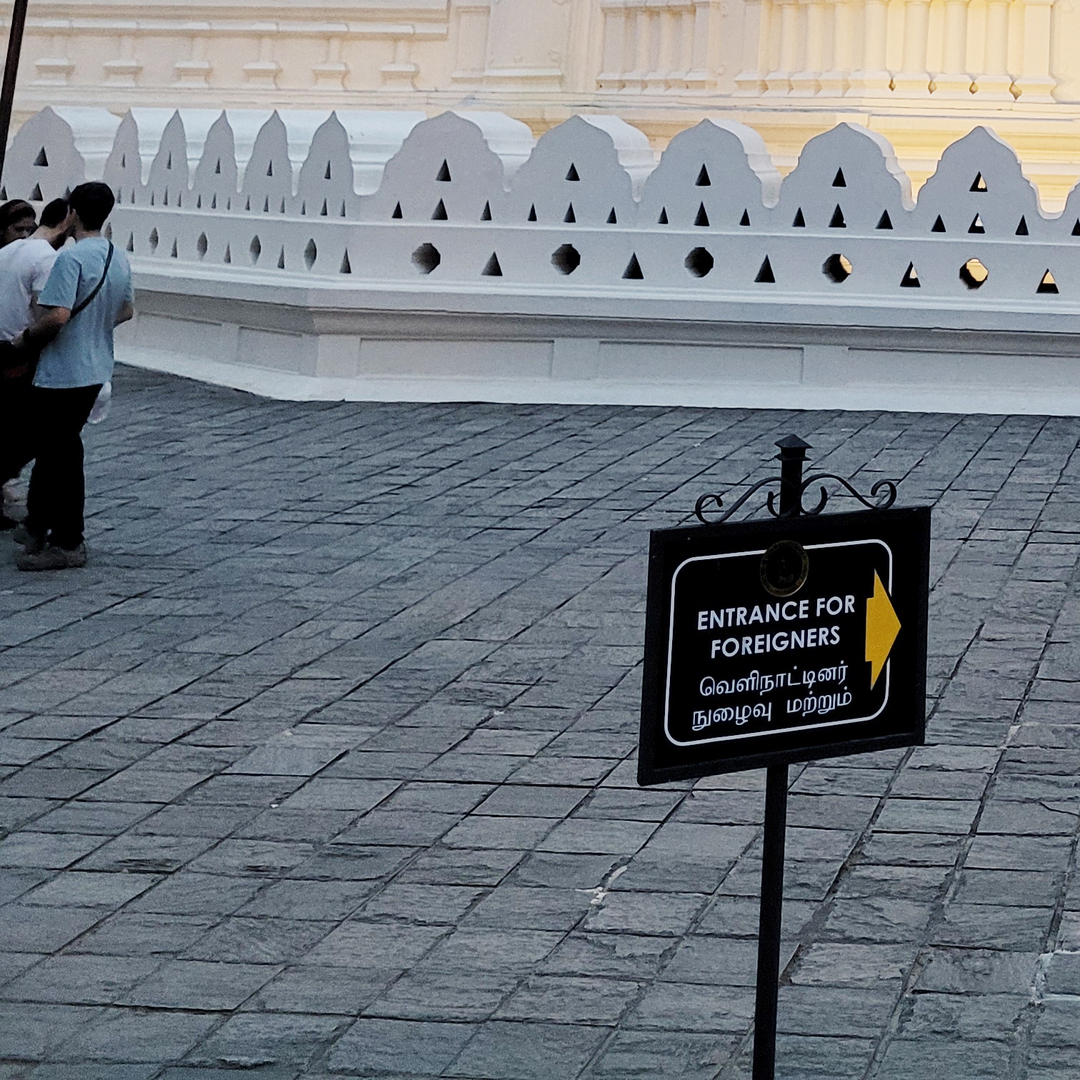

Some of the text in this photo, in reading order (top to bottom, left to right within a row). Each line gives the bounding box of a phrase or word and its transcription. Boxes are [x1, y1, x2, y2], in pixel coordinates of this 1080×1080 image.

[697, 594, 855, 630] ENTRANCE FOR
[710, 625, 841, 658] FOREIGNERS
[699, 660, 849, 696] வெளிநாட்டினர்
[692, 686, 852, 731] நுழைவு மற்றும்
